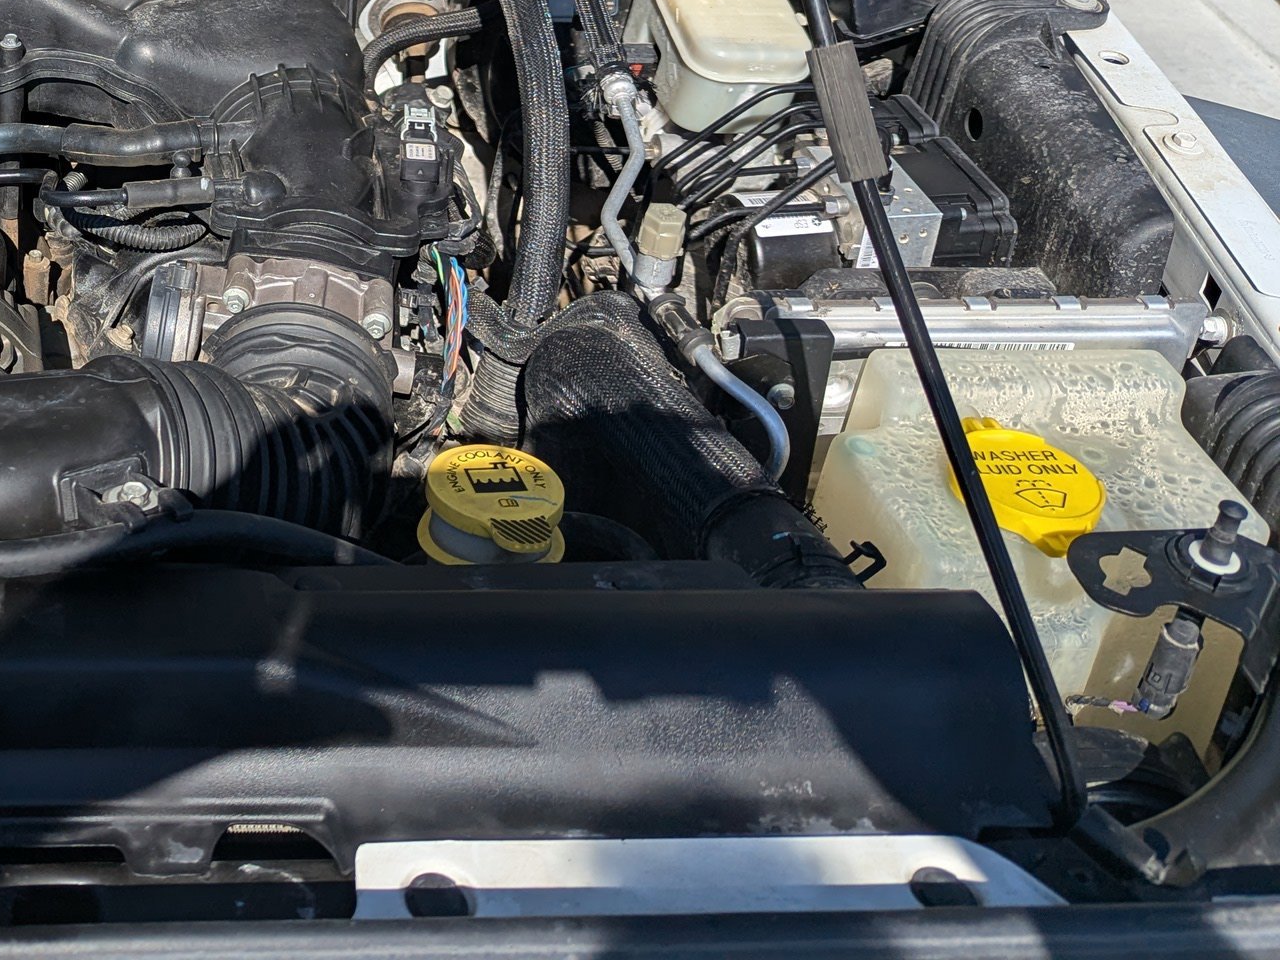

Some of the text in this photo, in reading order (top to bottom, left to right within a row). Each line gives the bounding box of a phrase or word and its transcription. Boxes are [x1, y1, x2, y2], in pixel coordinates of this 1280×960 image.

[973, 450, 1058, 461] WASHER
[446, 450, 547, 493] ENGINE COOLANT ONLY
[978, 463, 1079, 475] LUID ONLY
